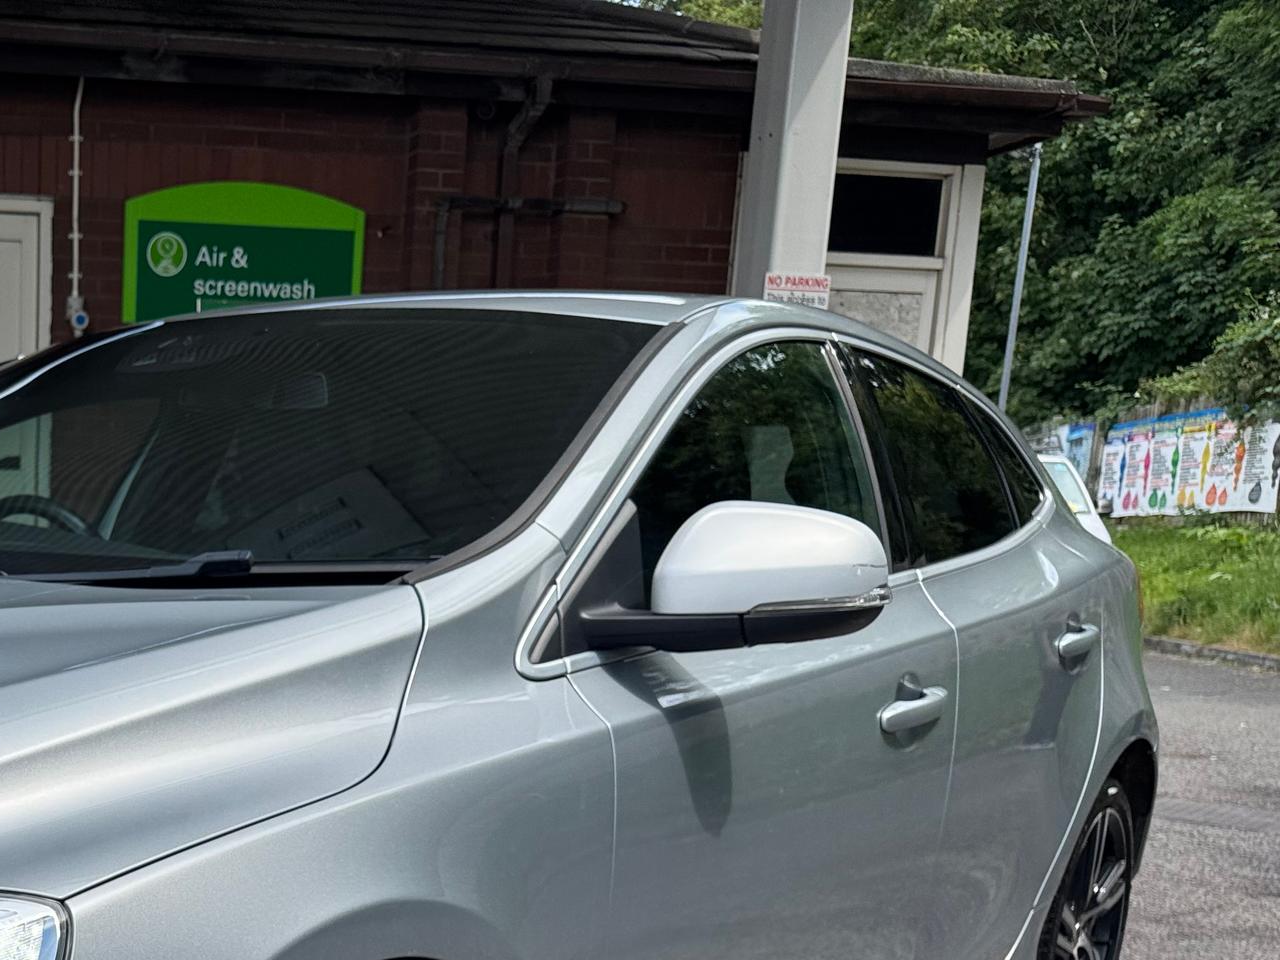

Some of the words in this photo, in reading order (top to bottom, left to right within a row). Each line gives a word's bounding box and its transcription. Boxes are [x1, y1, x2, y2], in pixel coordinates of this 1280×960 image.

[194, 246, 228, 267] Air
[231, 246, 248, 268] &
[193, 278, 316, 300] screenwash
[767, 275, 783, 287] NO
[784, 275, 829, 289] PARKING
